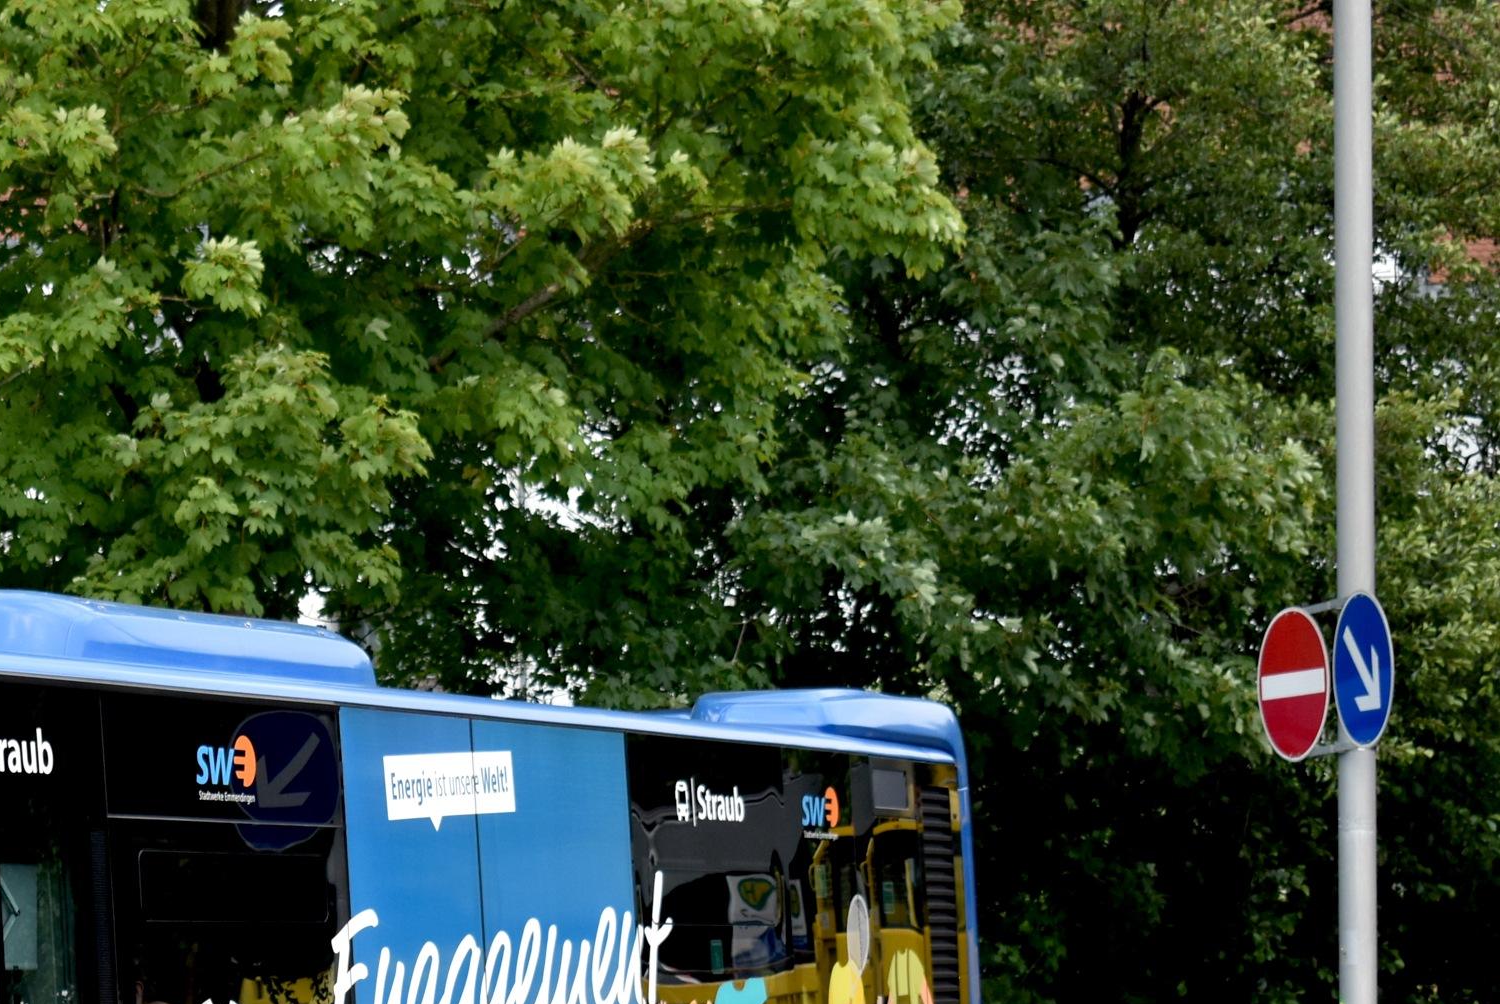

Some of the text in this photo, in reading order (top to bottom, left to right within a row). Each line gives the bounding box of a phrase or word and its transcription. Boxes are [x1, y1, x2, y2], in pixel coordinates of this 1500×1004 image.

[390, 766, 509, 806] Energie ist unsere Welt!
[697, 784, 745, 822] Straub
